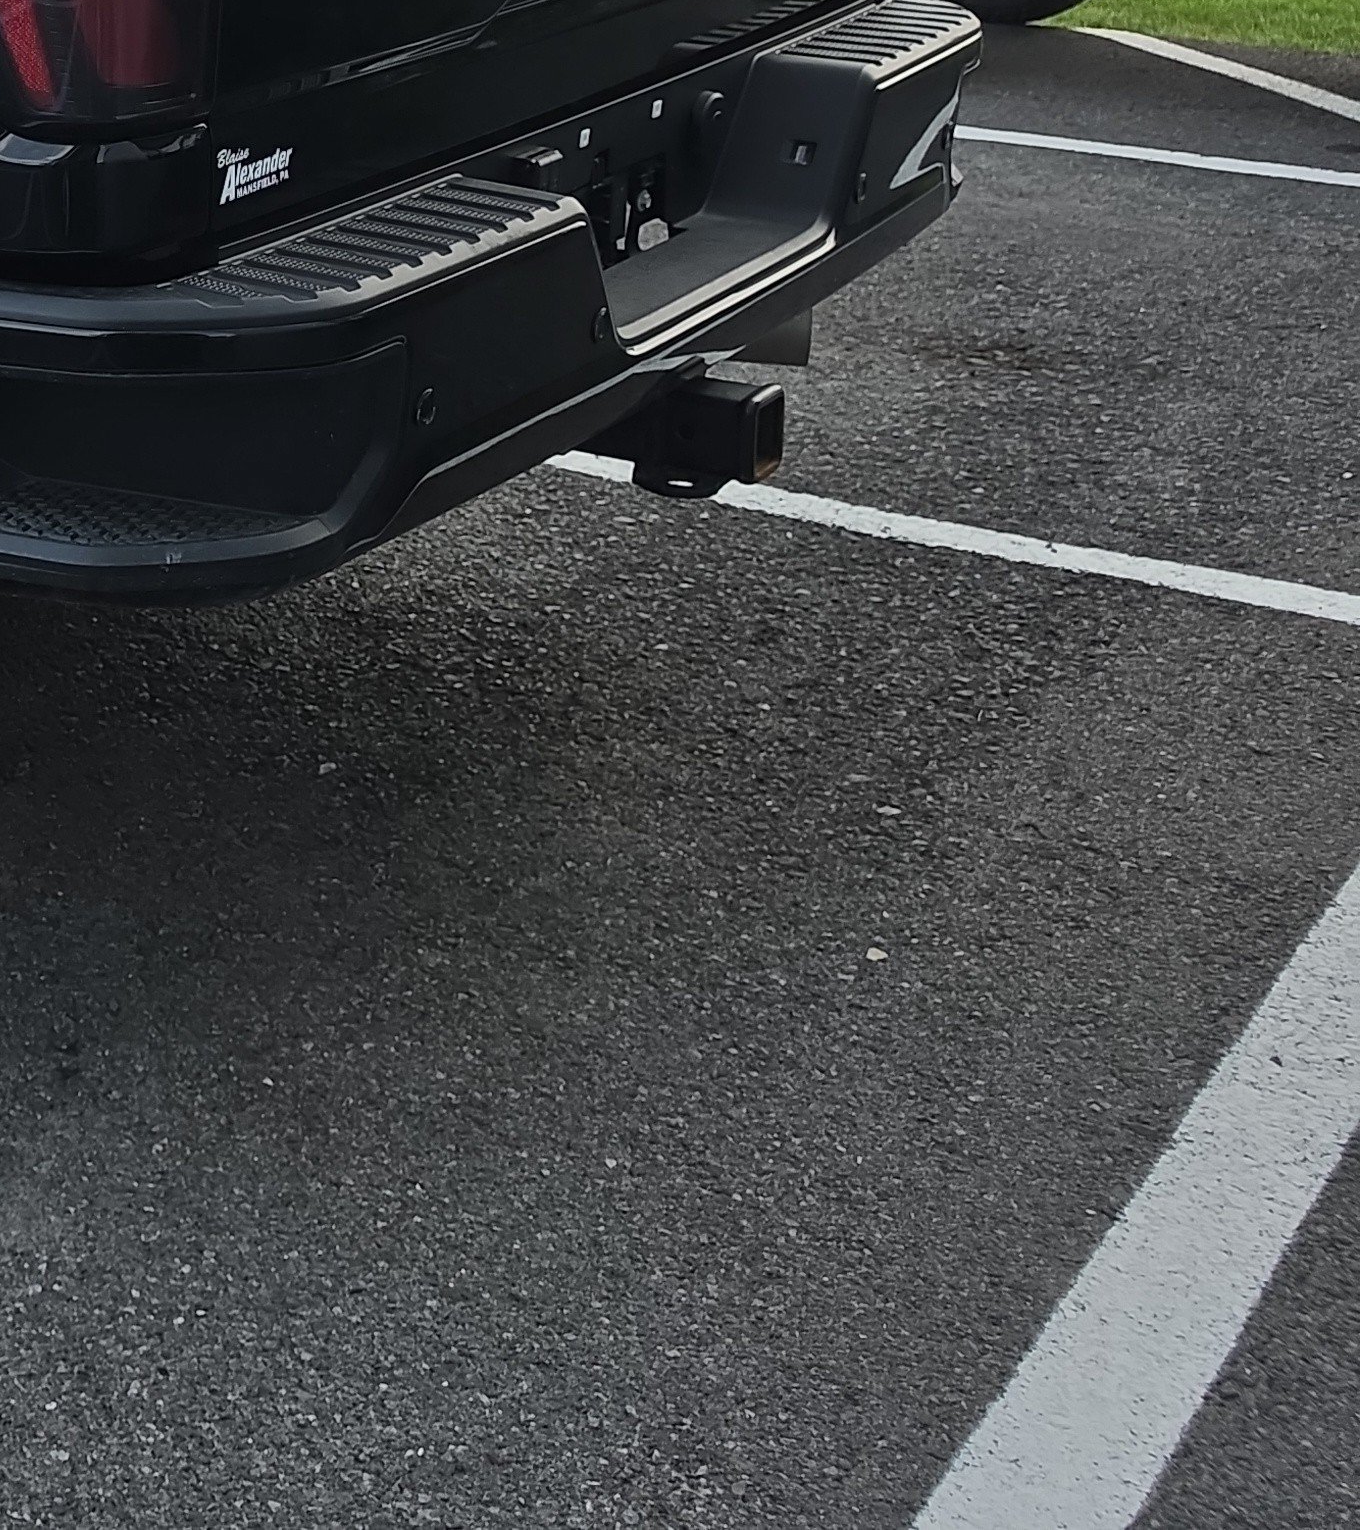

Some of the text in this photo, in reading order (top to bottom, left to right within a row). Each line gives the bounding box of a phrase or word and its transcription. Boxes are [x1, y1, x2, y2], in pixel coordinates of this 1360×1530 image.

[217, 148, 249, 168] Blaise
[219, 148, 293, 205] Alexander
[236, 169, 290, 198] MANSFIELD, PA
